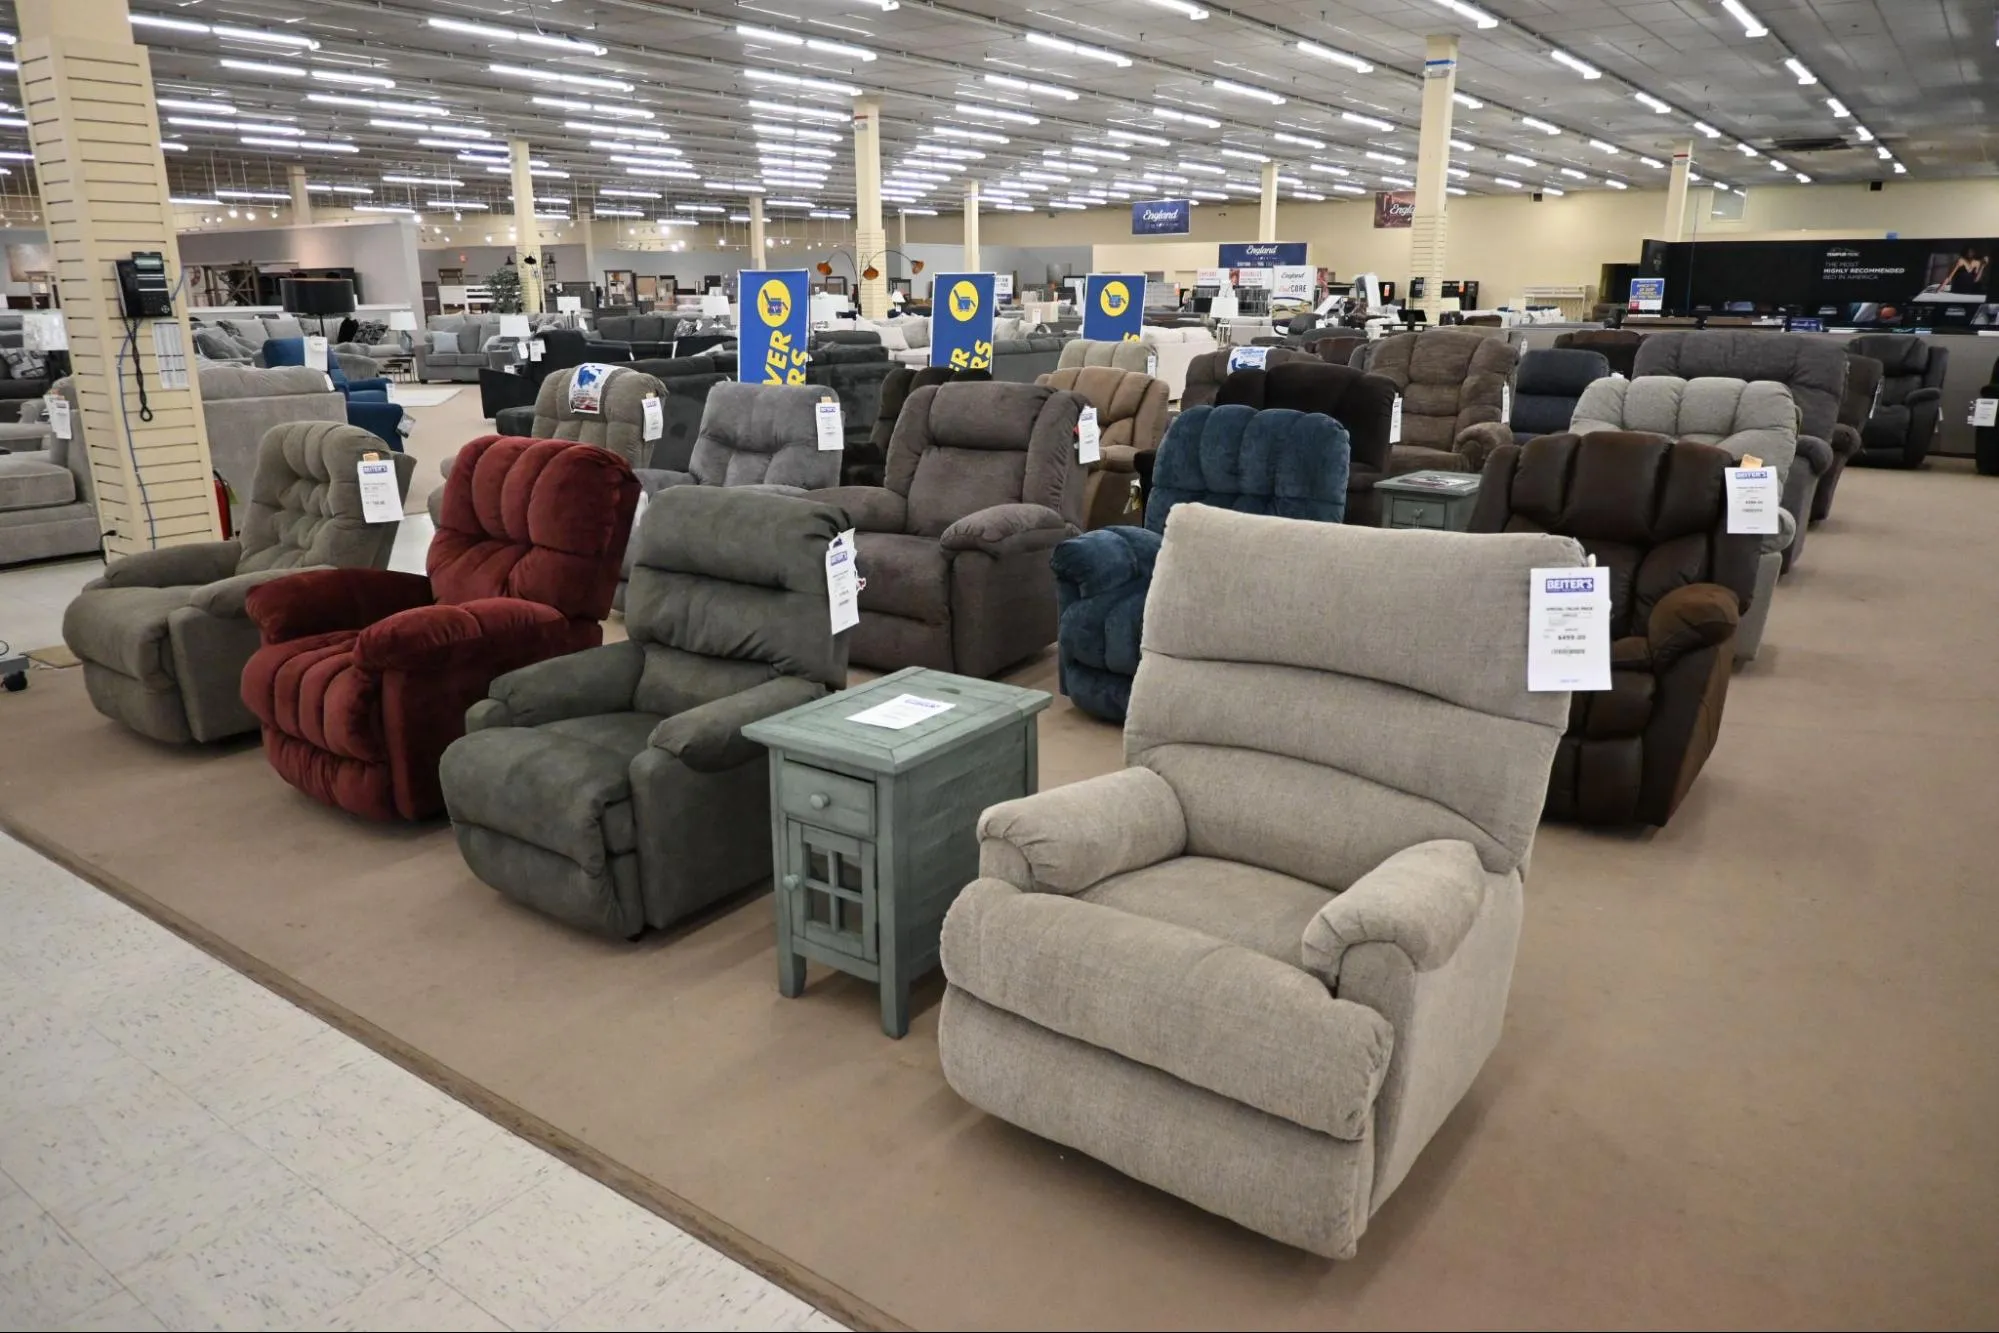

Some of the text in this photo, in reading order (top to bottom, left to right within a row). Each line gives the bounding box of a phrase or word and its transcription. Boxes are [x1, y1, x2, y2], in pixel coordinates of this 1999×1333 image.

[1142, 208, 1179, 221] England
[1389, 203, 1417, 216] Engla
[1245, 245, 1279, 255] England
[1547, 579, 1593, 590] BEITER'S
